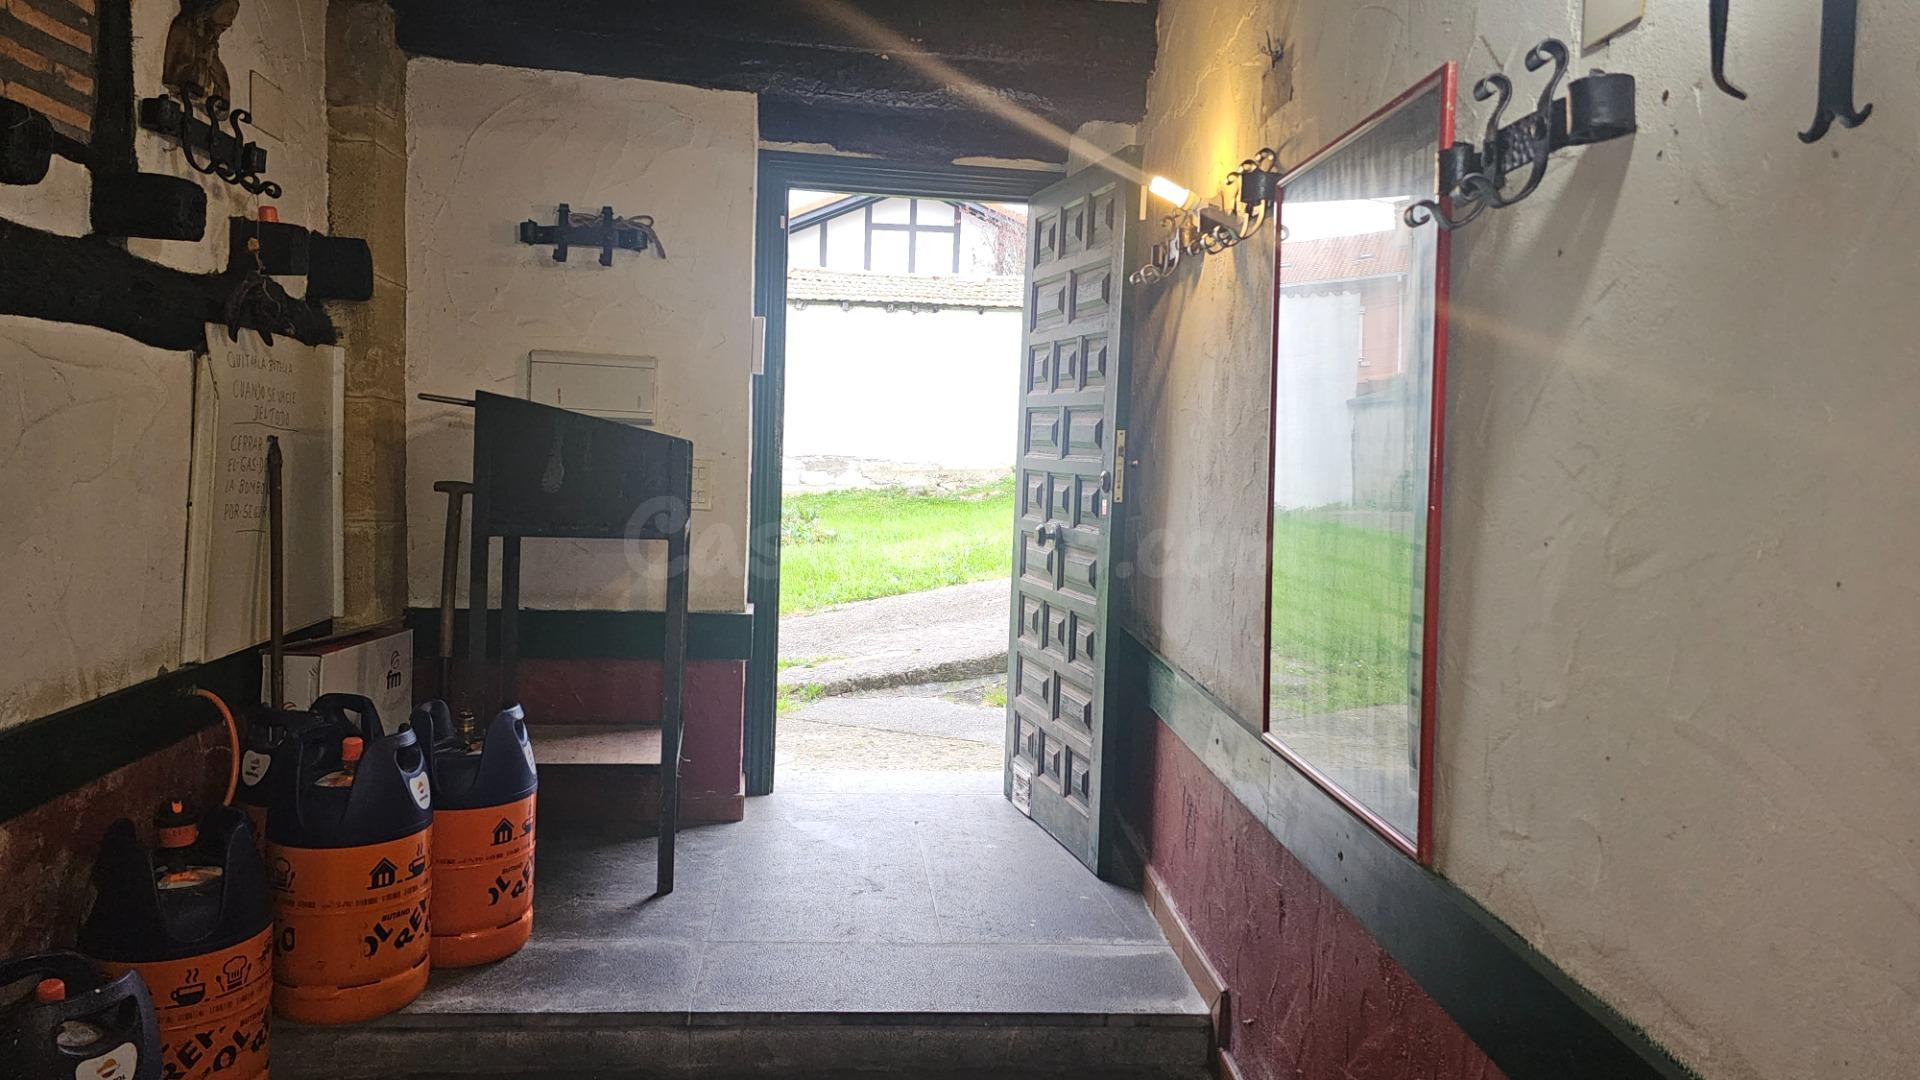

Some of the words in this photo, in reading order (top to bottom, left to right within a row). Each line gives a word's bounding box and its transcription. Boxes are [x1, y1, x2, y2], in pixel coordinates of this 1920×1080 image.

[232, 378, 266, 401] CUANDO
[267, 386, 277, 403] SE
[230, 434, 263, 452] CERRAR
[239, 456, 257, 473] GAS
[224, 479, 235, 494] LA
[223, 503, 240, 521] POR
[381, 908, 411, 922] BUTANO
